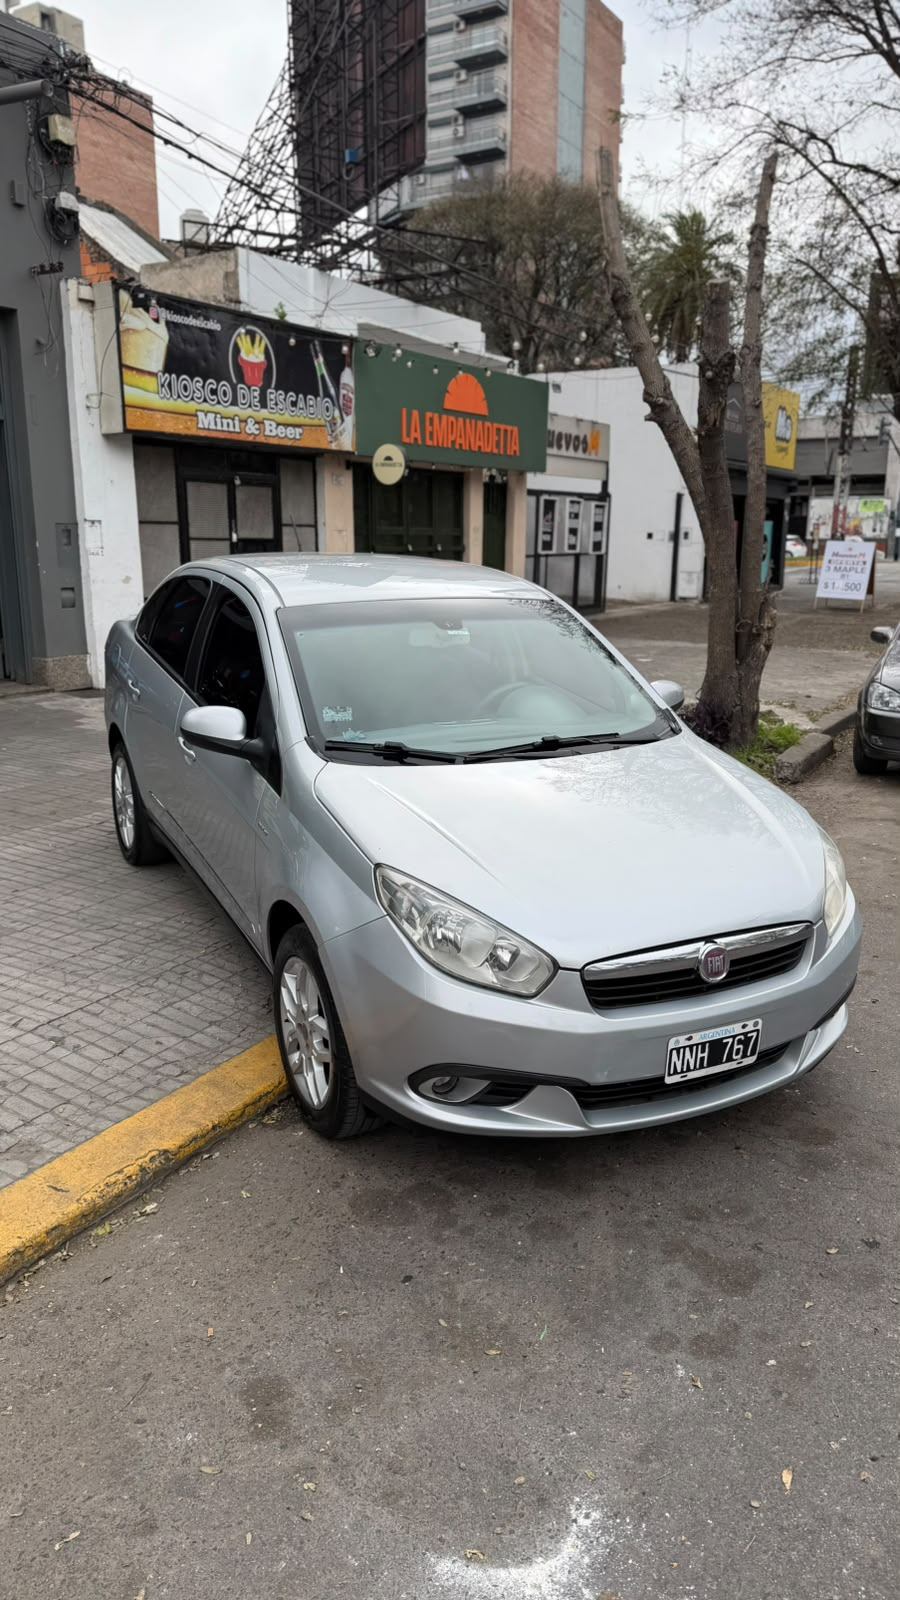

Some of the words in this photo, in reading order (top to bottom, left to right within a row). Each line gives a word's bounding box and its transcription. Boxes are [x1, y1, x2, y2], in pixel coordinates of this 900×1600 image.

[158, 373, 232, 406] KIOSCO
[237, 385, 260, 410] DE
[267, 389, 334, 421] ESCABIO
[196, 411, 241, 432] Mini
[245, 418, 260, 435] &
[263, 419, 304, 440] Beer
[402, 408, 422, 444] LA
[425, 412, 520, 456] EMPANADETTA
[547, 430, 589, 454] uevos
[707, 955, 725, 973] FIAT
[698, 1027, 736, 1041] ARGENTINA
[670, 1042, 709, 1075] NNH
[722, 1031, 757, 1063] 767
